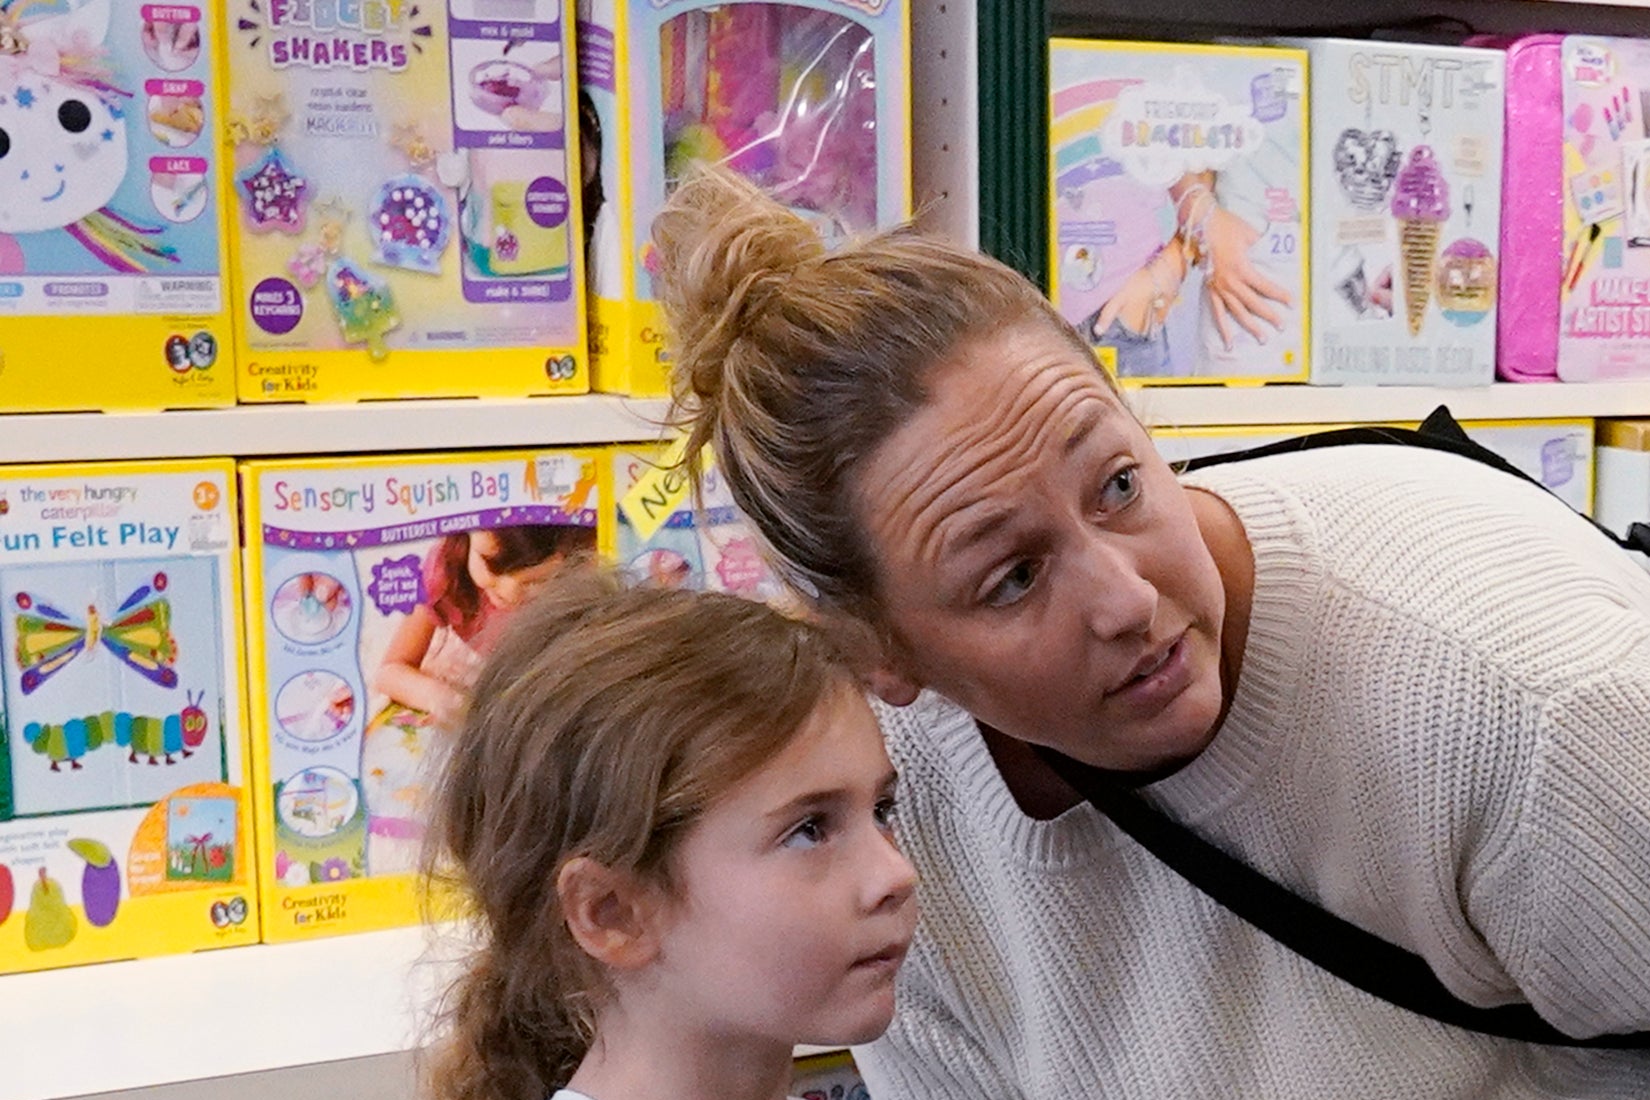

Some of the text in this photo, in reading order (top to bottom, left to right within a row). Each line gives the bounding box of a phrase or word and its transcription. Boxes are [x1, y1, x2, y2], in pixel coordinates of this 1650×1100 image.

[272, 38, 408, 67] SHAKERS
[1347, 52, 1463, 110] STMT
[1270, 234, 1296, 255] 20
[248, 363, 318, 378] Creativity
[261, 377, 318, 391] for Kids
[20, 484, 139, 503] the very hungry
[273, 468, 511, 513] Sensory Squish Bag
[640, 468, 690, 521] Ne
[0, 522, 180, 551] un Felt Play
[380, 513, 481, 542] BUTTERFLY GARDEN
[282, 893, 347, 911] Creativity
[293, 907, 347, 925] for Kids
